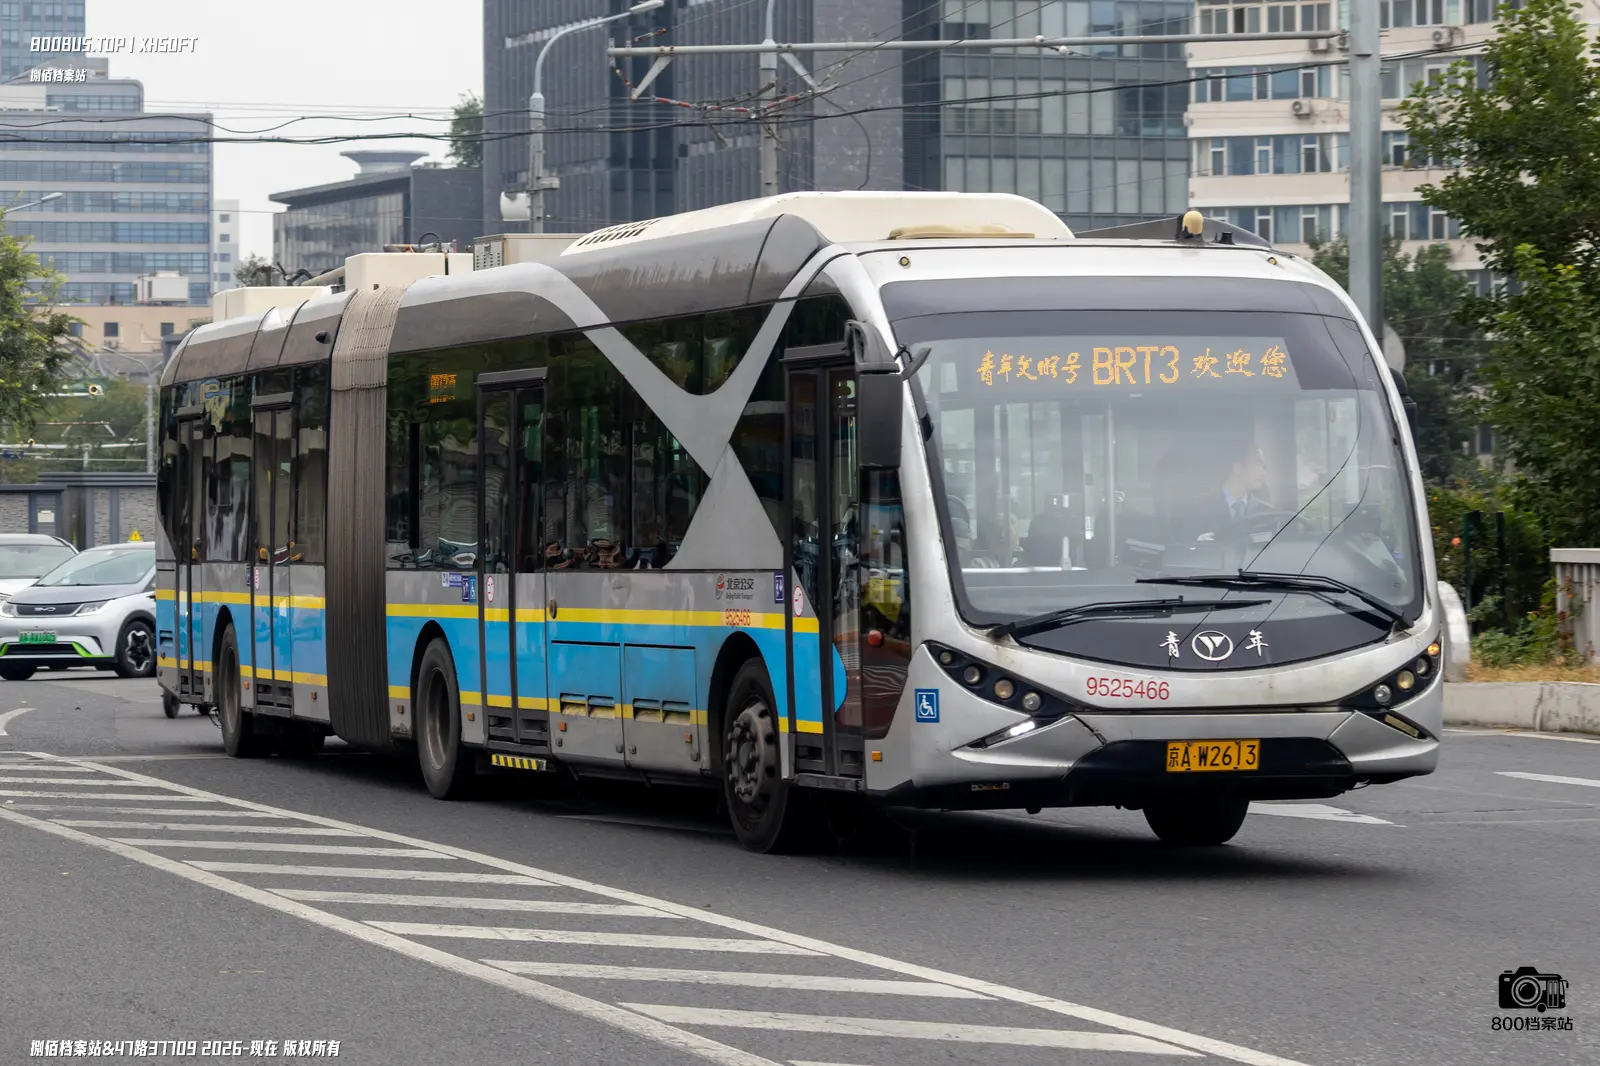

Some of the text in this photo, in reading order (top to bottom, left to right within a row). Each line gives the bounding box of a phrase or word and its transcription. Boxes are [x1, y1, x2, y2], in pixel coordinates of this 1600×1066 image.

[1092, 345, 1180, 385] BRT3
[726, 578, 754, 590] 北京公交
[1086, 676, 1170, 700] 9525466
